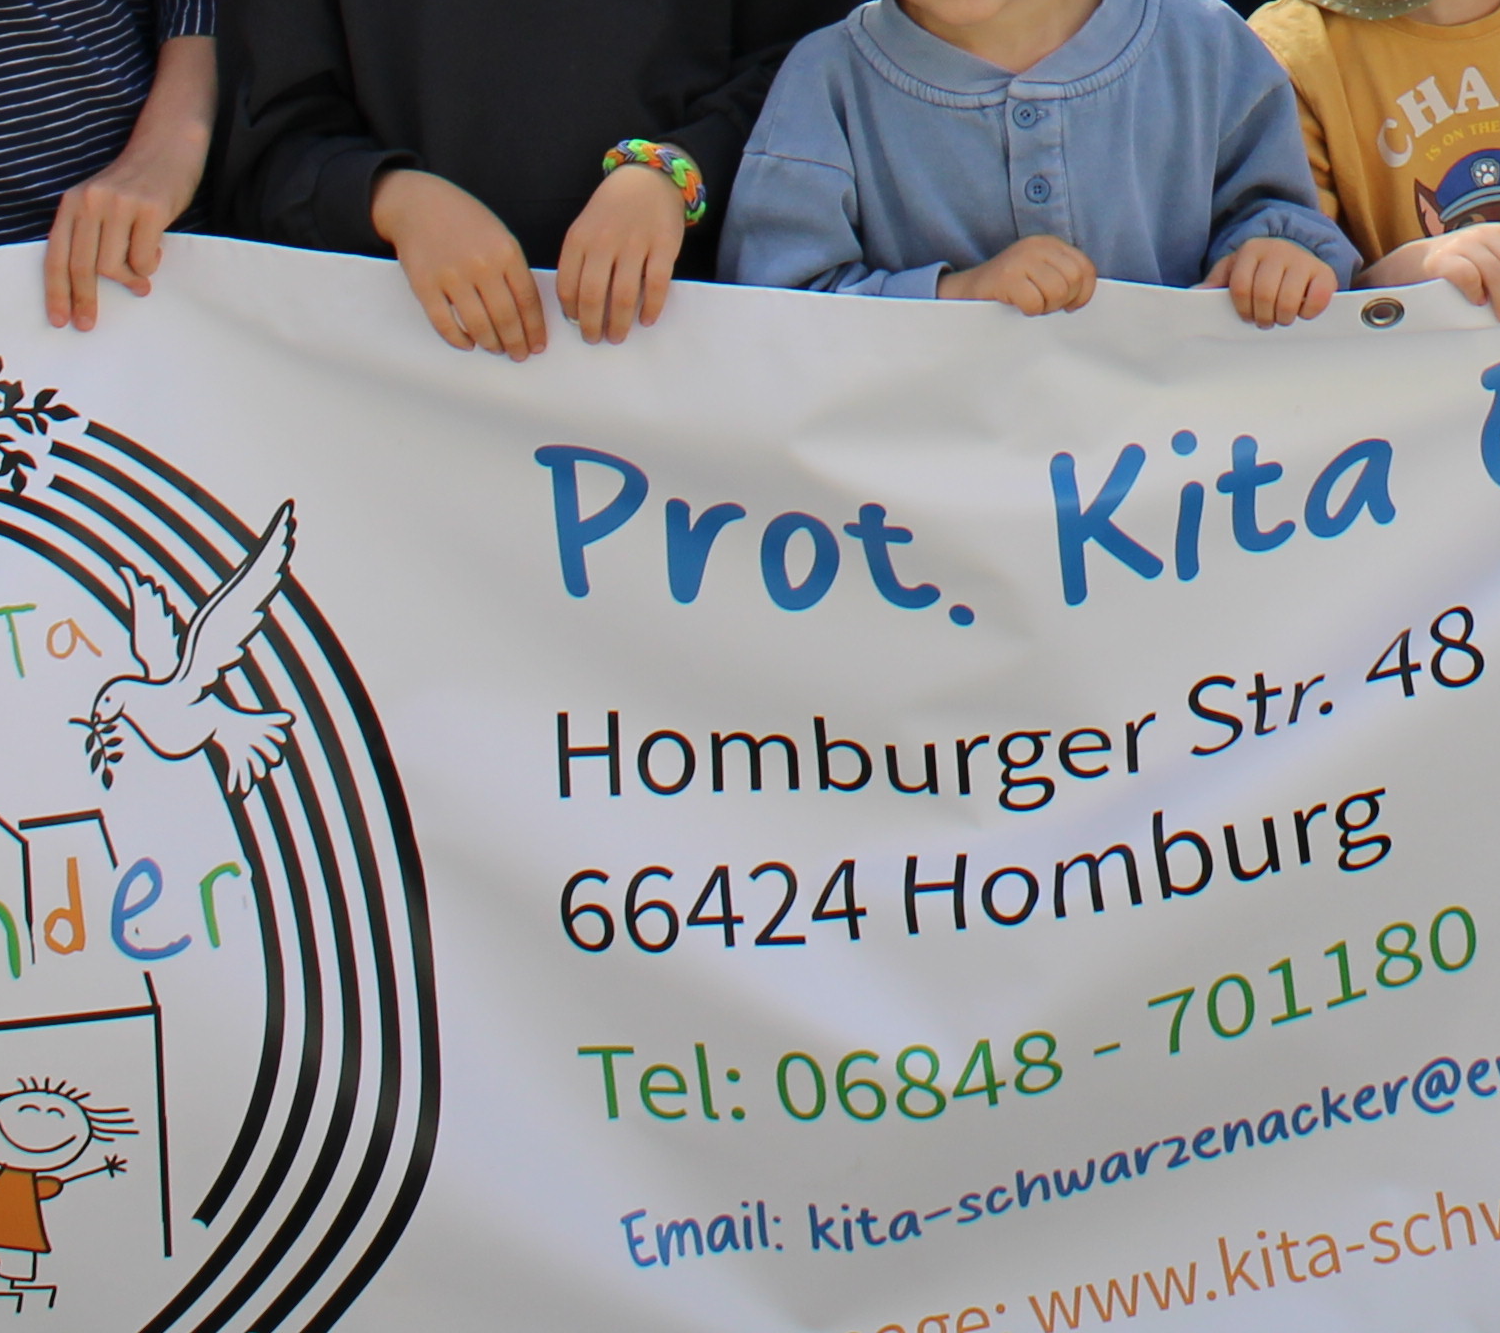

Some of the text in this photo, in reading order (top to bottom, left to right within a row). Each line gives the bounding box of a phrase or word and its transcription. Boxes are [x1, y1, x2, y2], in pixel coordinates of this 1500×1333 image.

[1425, 144, 1442, 163] IS
[1442, 128, 1466, 148] ON
[534, 441, 977, 629] Prot.
[1049, 425, 1400, 608] Kita
[555, 605, 1486, 813] Homburger Str. 48
[559, 785, 1395, 954] 66424 Homburg
[577, 904, 1479, 1124] Tel: 06848 - 701180
[619, 1200, 788, 1269] Email:
